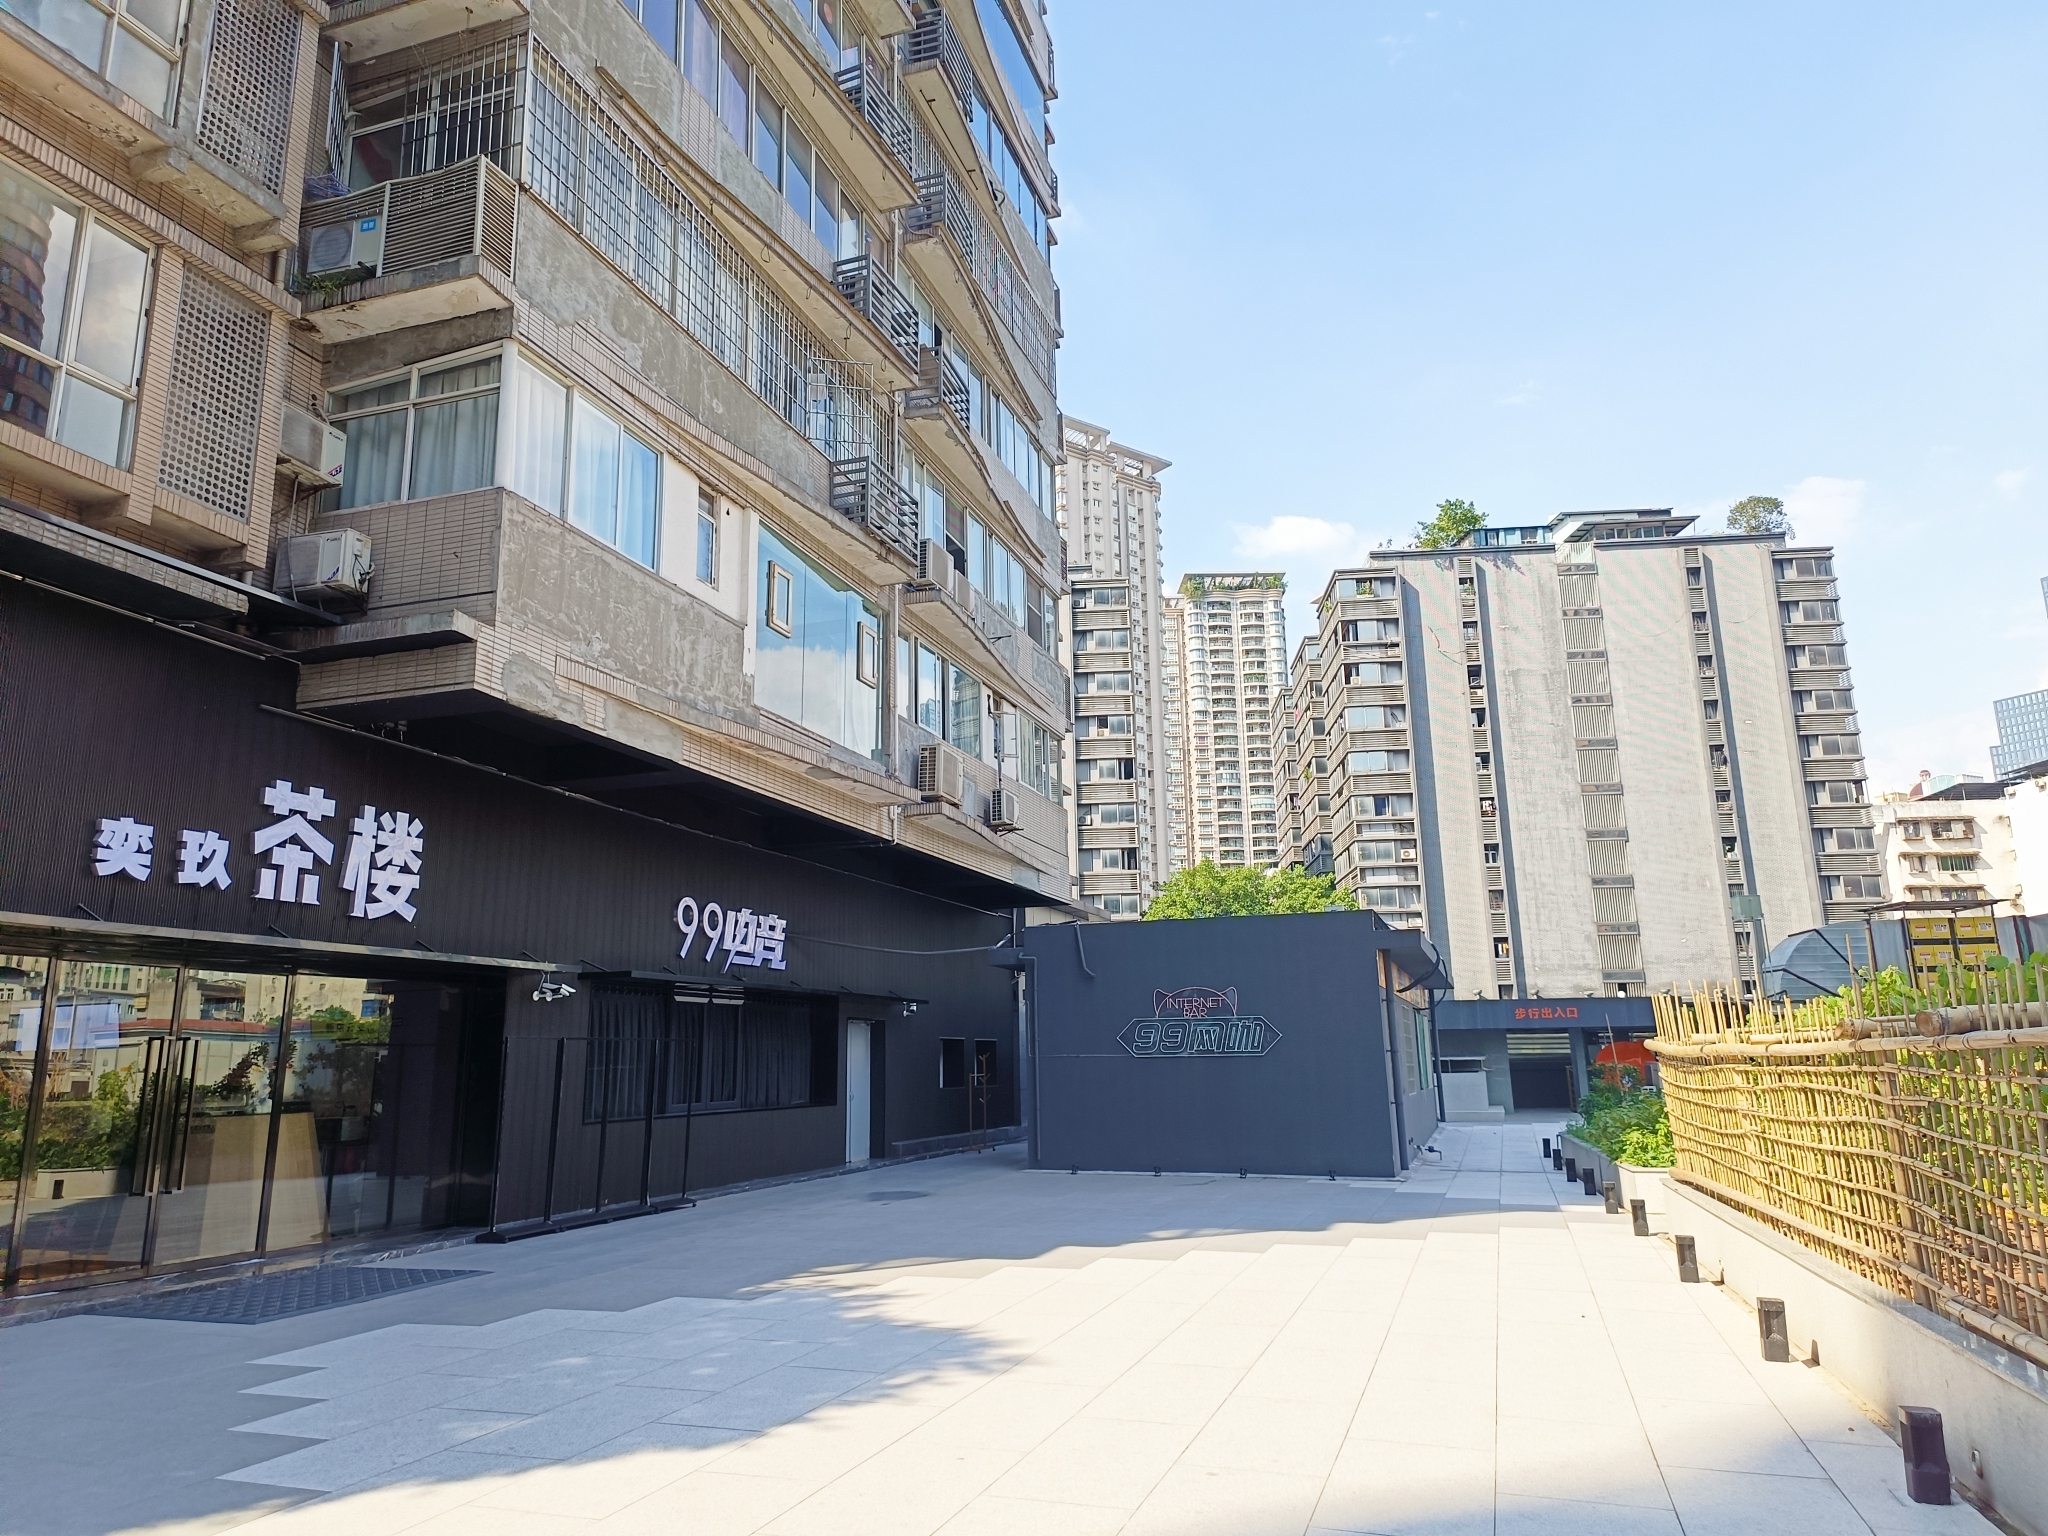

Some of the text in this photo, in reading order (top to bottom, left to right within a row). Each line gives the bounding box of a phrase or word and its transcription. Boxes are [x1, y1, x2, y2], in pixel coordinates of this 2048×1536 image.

[90, 779, 424, 922] 奕玖茶楼
[1166, 998, 1224, 1009] INTERNET
[1183, 1007, 1208, 1018] BAR
[1515, 1007, 1579, 1019] 步行出入口
[1132, 1021, 1265, 1053] 99网咖
